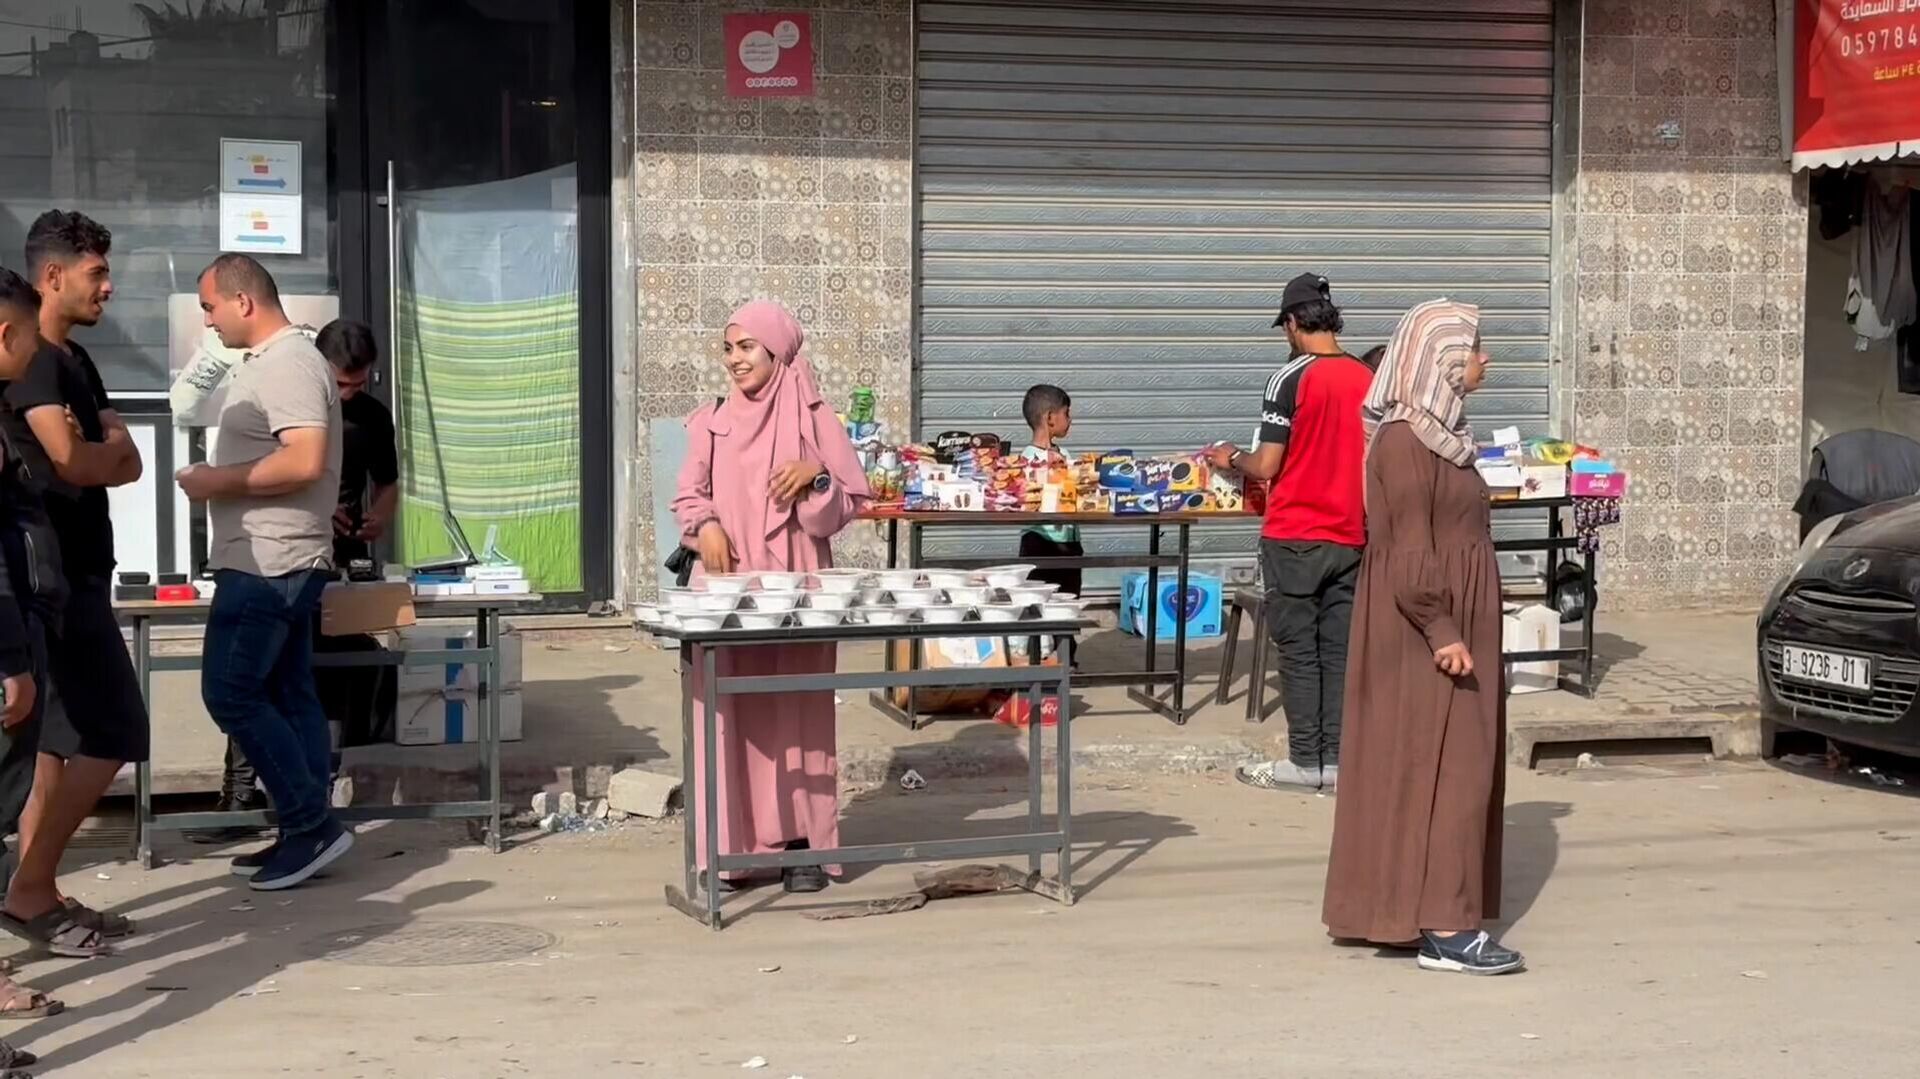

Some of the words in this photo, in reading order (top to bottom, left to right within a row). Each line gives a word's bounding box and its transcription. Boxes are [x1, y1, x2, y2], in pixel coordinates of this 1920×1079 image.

[1841, 24, 1918, 57] 059784
[1874, 66, 1899, 80] ساعة
[745, 76, 798, 88] ooredoo
